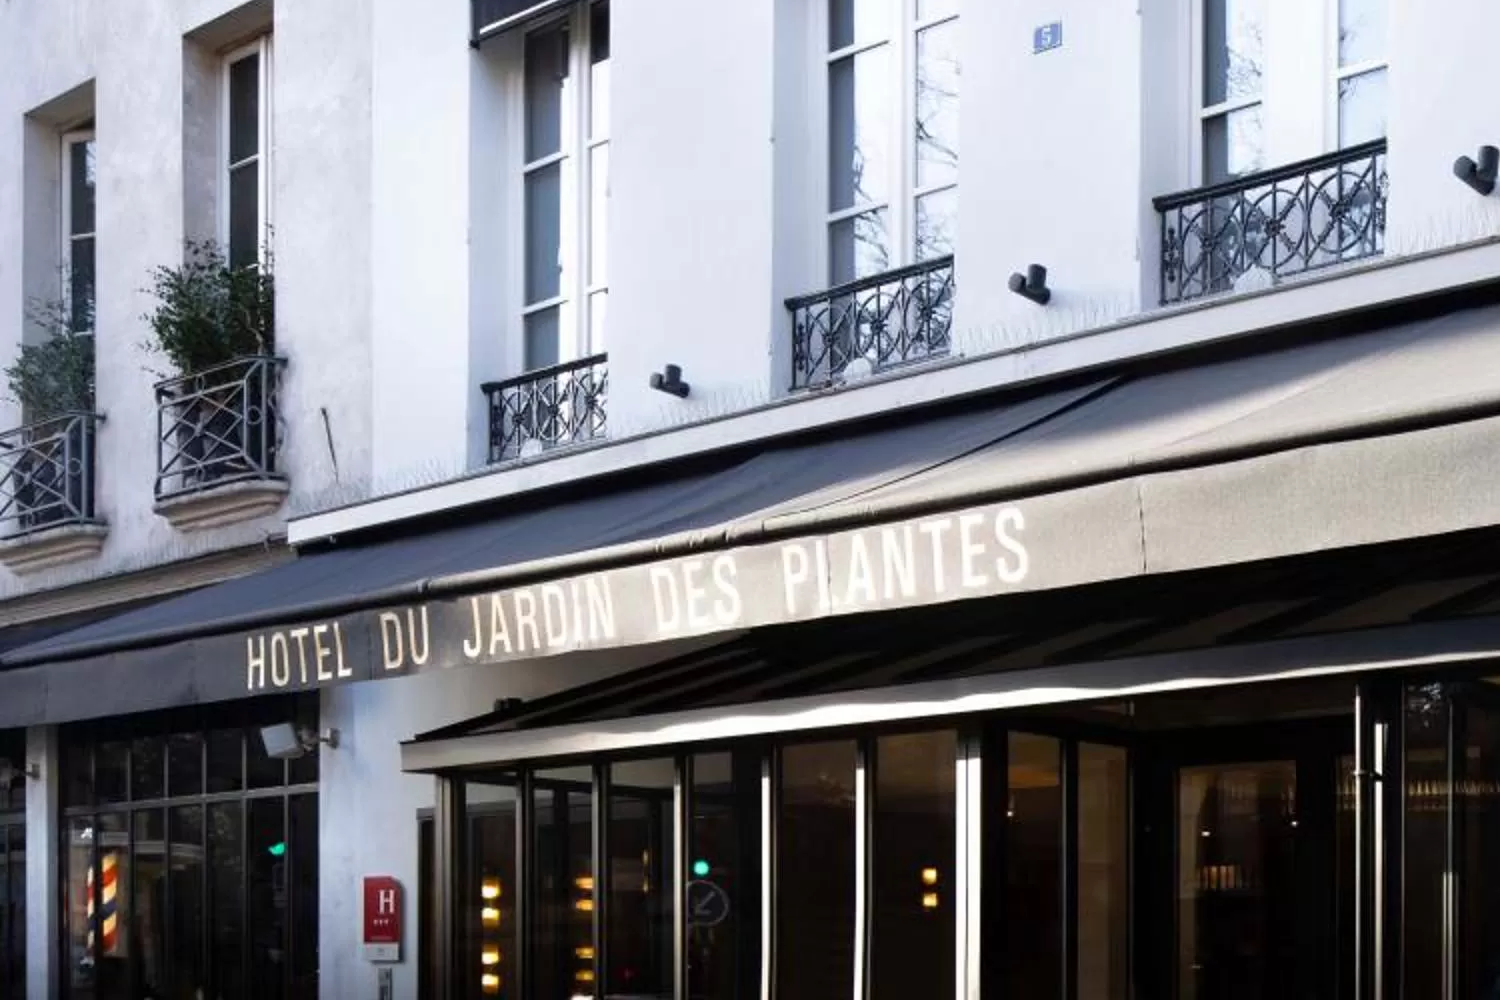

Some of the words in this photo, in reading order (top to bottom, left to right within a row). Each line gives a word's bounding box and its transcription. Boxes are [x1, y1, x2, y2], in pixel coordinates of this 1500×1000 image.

[246, 622, 353, 691] HOTEL
[379, 606, 430, 671] DU
[463, 574, 614, 659] JARDIN
[649, 555, 742, 632] DES
[780, 507, 1030, 616] PLANTES
[379, 889, 395, 913] H
